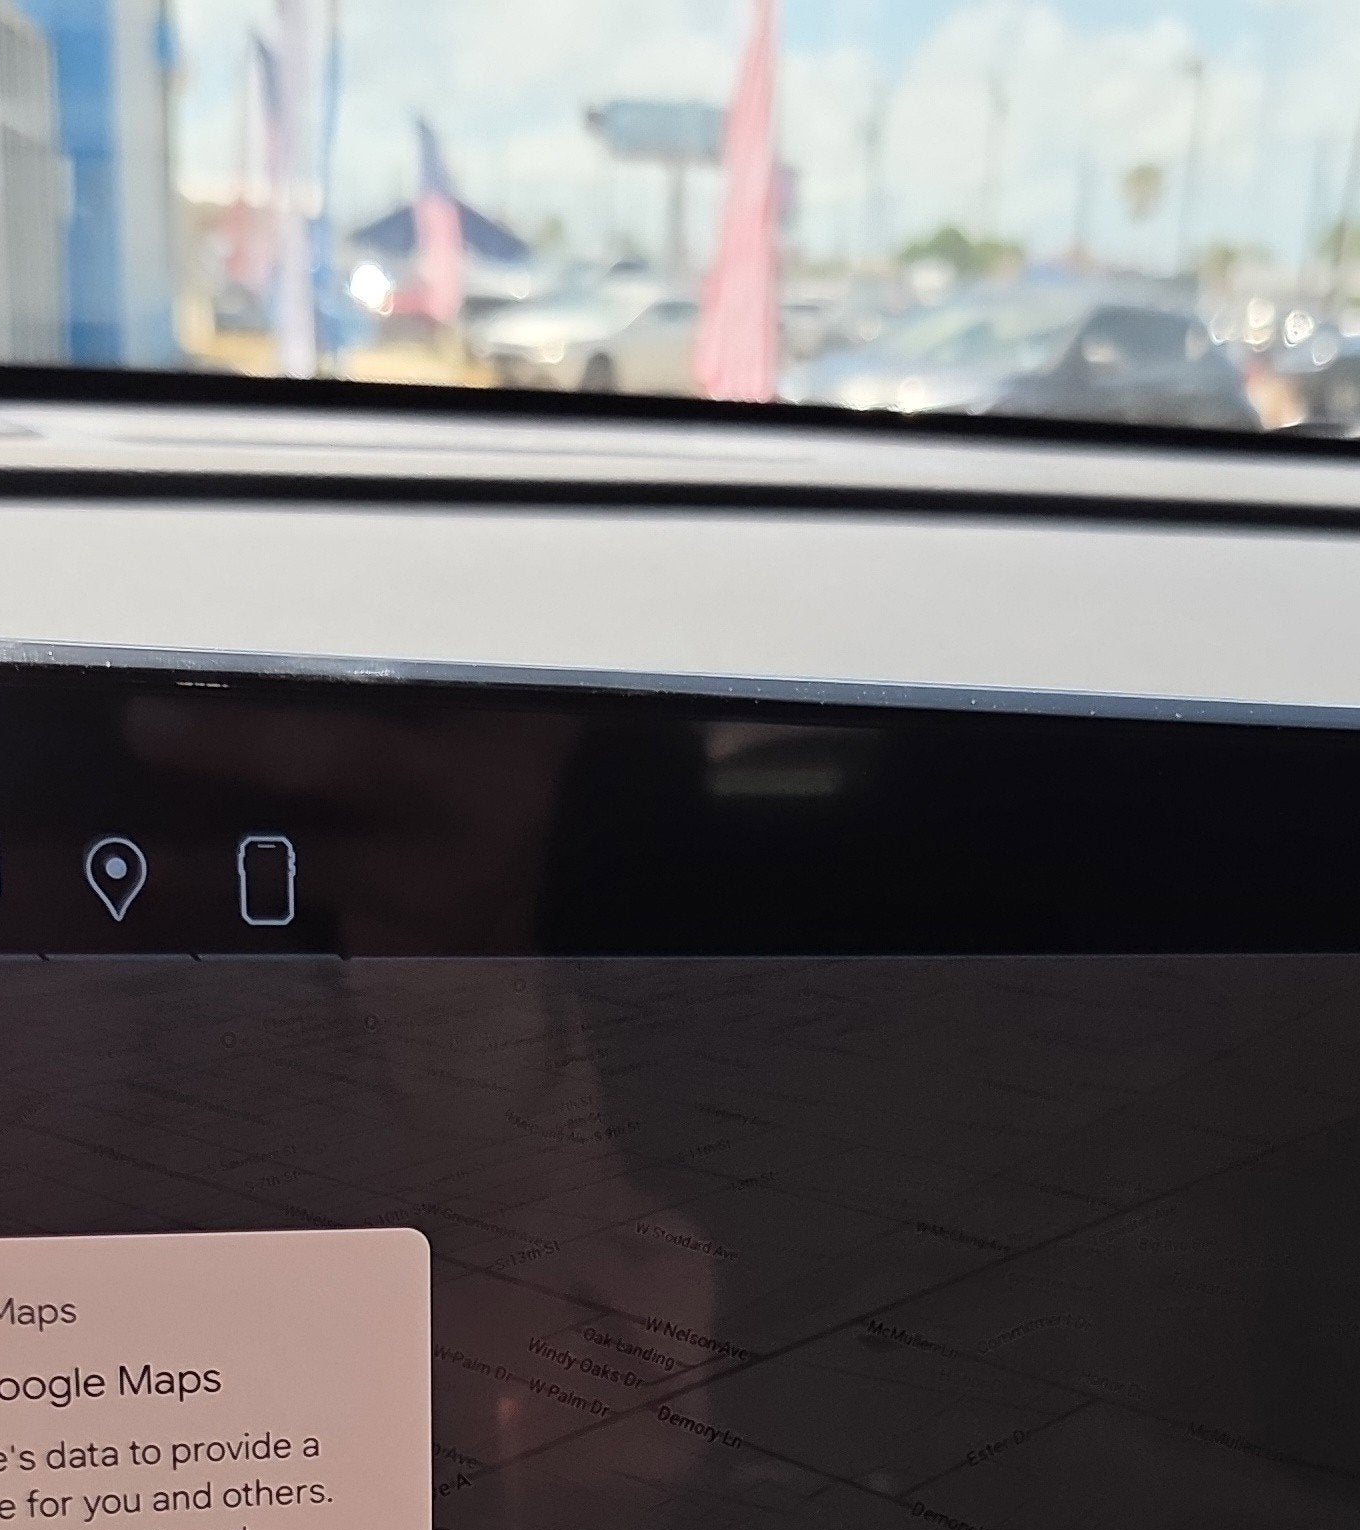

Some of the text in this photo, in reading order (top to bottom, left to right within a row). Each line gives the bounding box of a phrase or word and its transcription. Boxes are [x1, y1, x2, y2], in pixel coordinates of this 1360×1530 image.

[635, 1222, 650, 1235] W
[582, 1327, 677, 1371] Oak Landing
[645, 1316, 749, 1362] W Nelson Ave
[119, 1364, 221, 1402] Maps
[452, 1351, 491, 1376] Palm
[494, 1365, 515, 1384] Dr
[528, 1337, 644, 1390] Windy Oaks Dr
[529, 1377, 610, 1418] W Palm Dr
[655, 1405, 744, 1450] Demory Ln
[45, 1441, 119, 1470] data
[128, 1441, 161, 1465] to
[172, 1431, 291, 1471] provide
[302, 1438, 319, 1457] a
[966, 1438, 1009, 1467] Ester
[26, 1489, 73, 1518] for
[82, 1493, 140, 1526] you
[153, 1481, 211, 1512] and
[222, 1479, 333, 1508] others.
